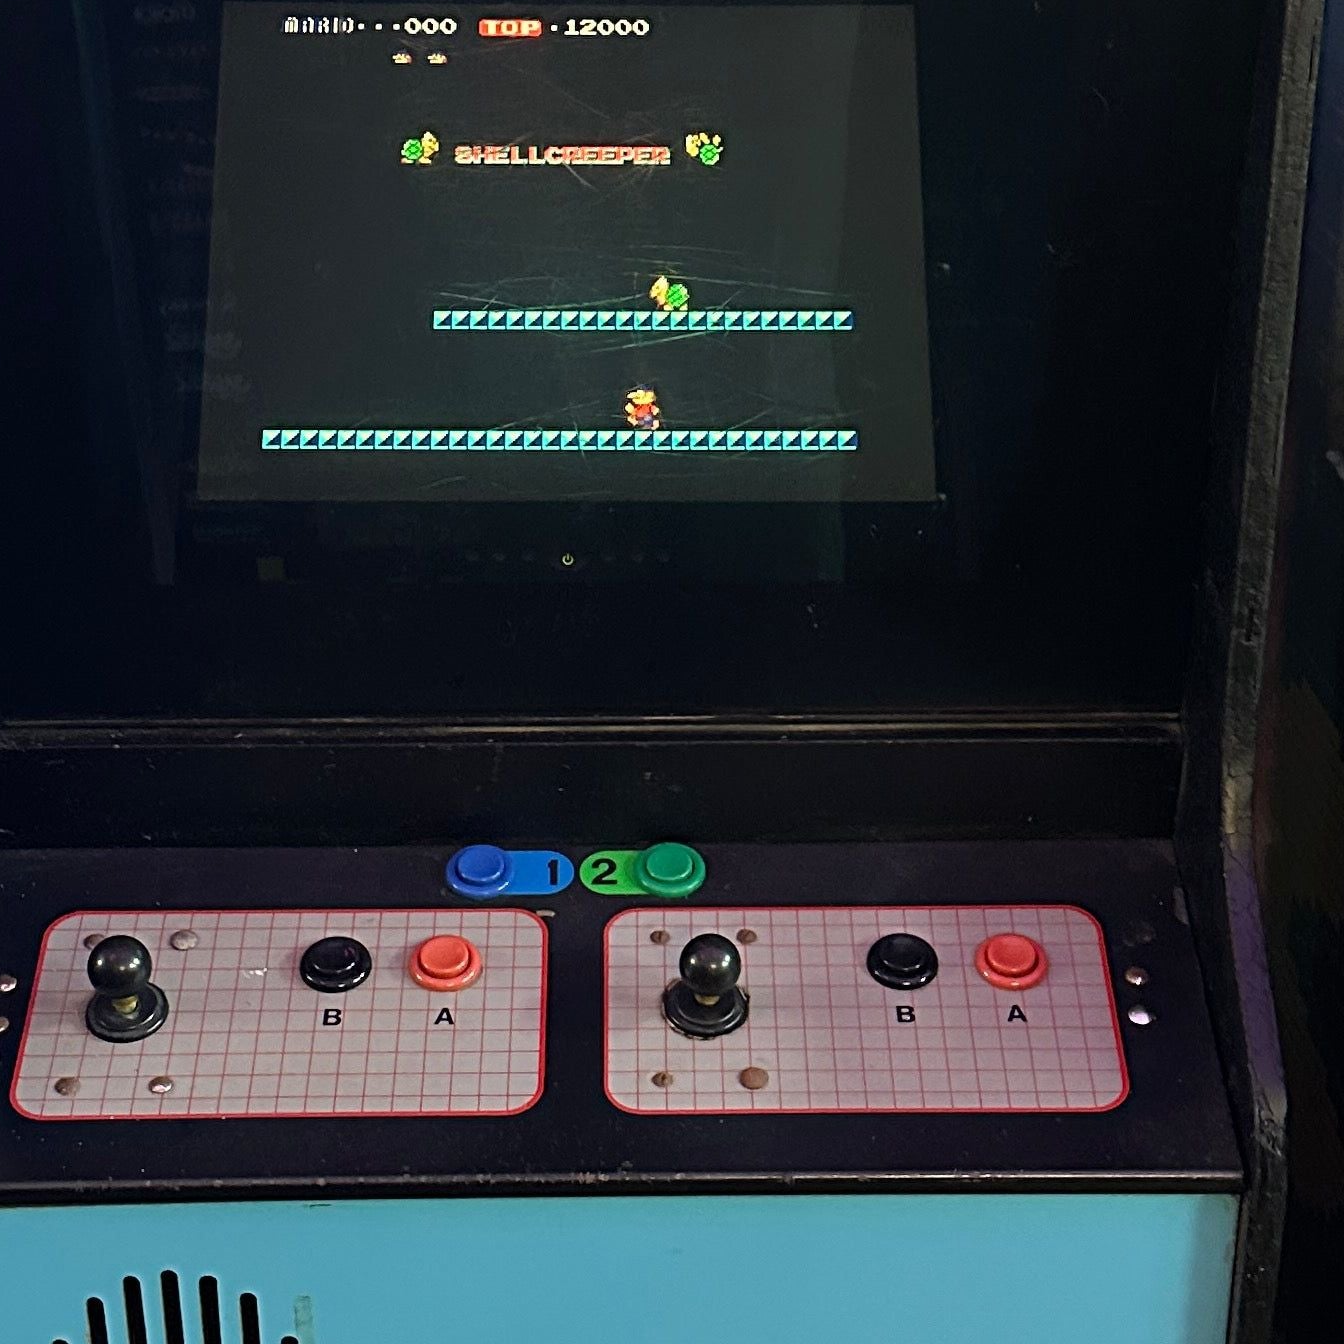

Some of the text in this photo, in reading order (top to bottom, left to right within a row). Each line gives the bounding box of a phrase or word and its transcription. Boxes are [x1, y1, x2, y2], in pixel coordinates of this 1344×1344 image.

[485, 20, 542, 36] TOP
[563, 18, 650, 36] 12000
[454, 145, 671, 166] SHELLCREEPER
[547, 859, 560, 885] 1
[591, 859, 618, 885] 2
[322, 1007, 455, 1027] B A
[894, 1004, 1028, 1024] B A
